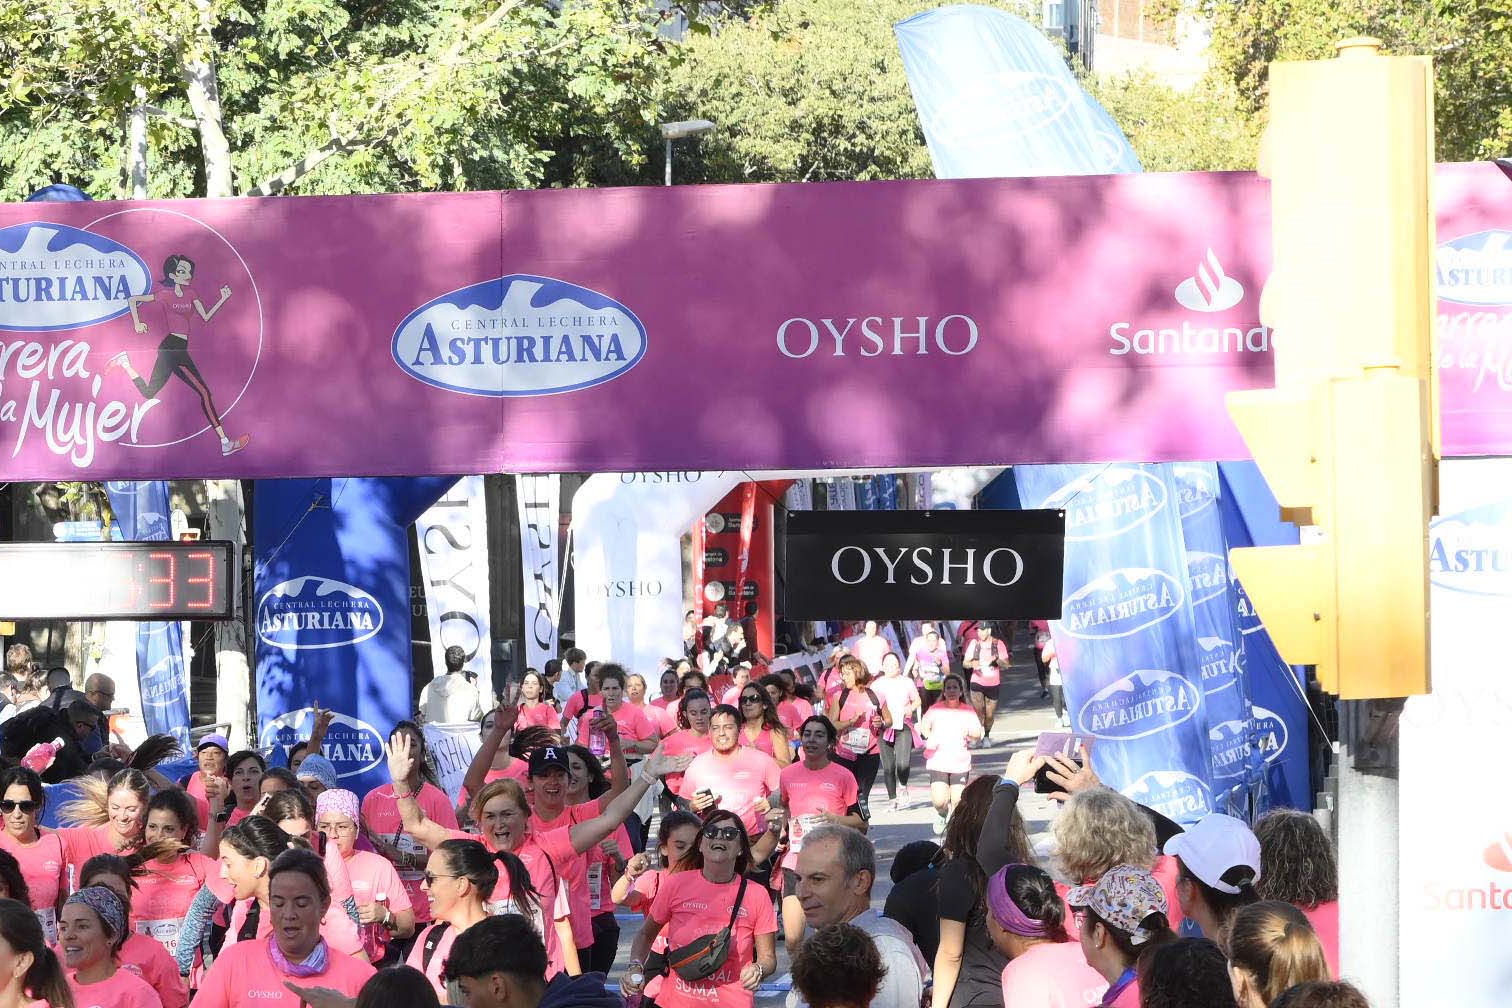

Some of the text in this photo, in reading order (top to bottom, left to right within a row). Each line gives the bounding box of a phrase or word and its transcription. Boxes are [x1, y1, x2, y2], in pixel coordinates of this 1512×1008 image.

[48, 257, 126, 270] LECHERA
[450, 315, 619, 330] CENTRAL LECHERA
[411, 322, 627, 367] ASTURIANA
[776, 314, 979, 358] OYSHO
[1110, 321, 1276, 356] Santand
[13, 375, 161, 468] Mujer
[830, 546, 1024, 587] OYSHO
[274, 600, 370, 609] CENTRAL LECHERA
[261, 606, 374, 633] ASTURIANA
[276, 732, 310, 741] CENTRA
[545, 748, 557, 759] A
[248, 989, 282, 1000] OYSHO
[675, 977, 718, 997] SUMA
